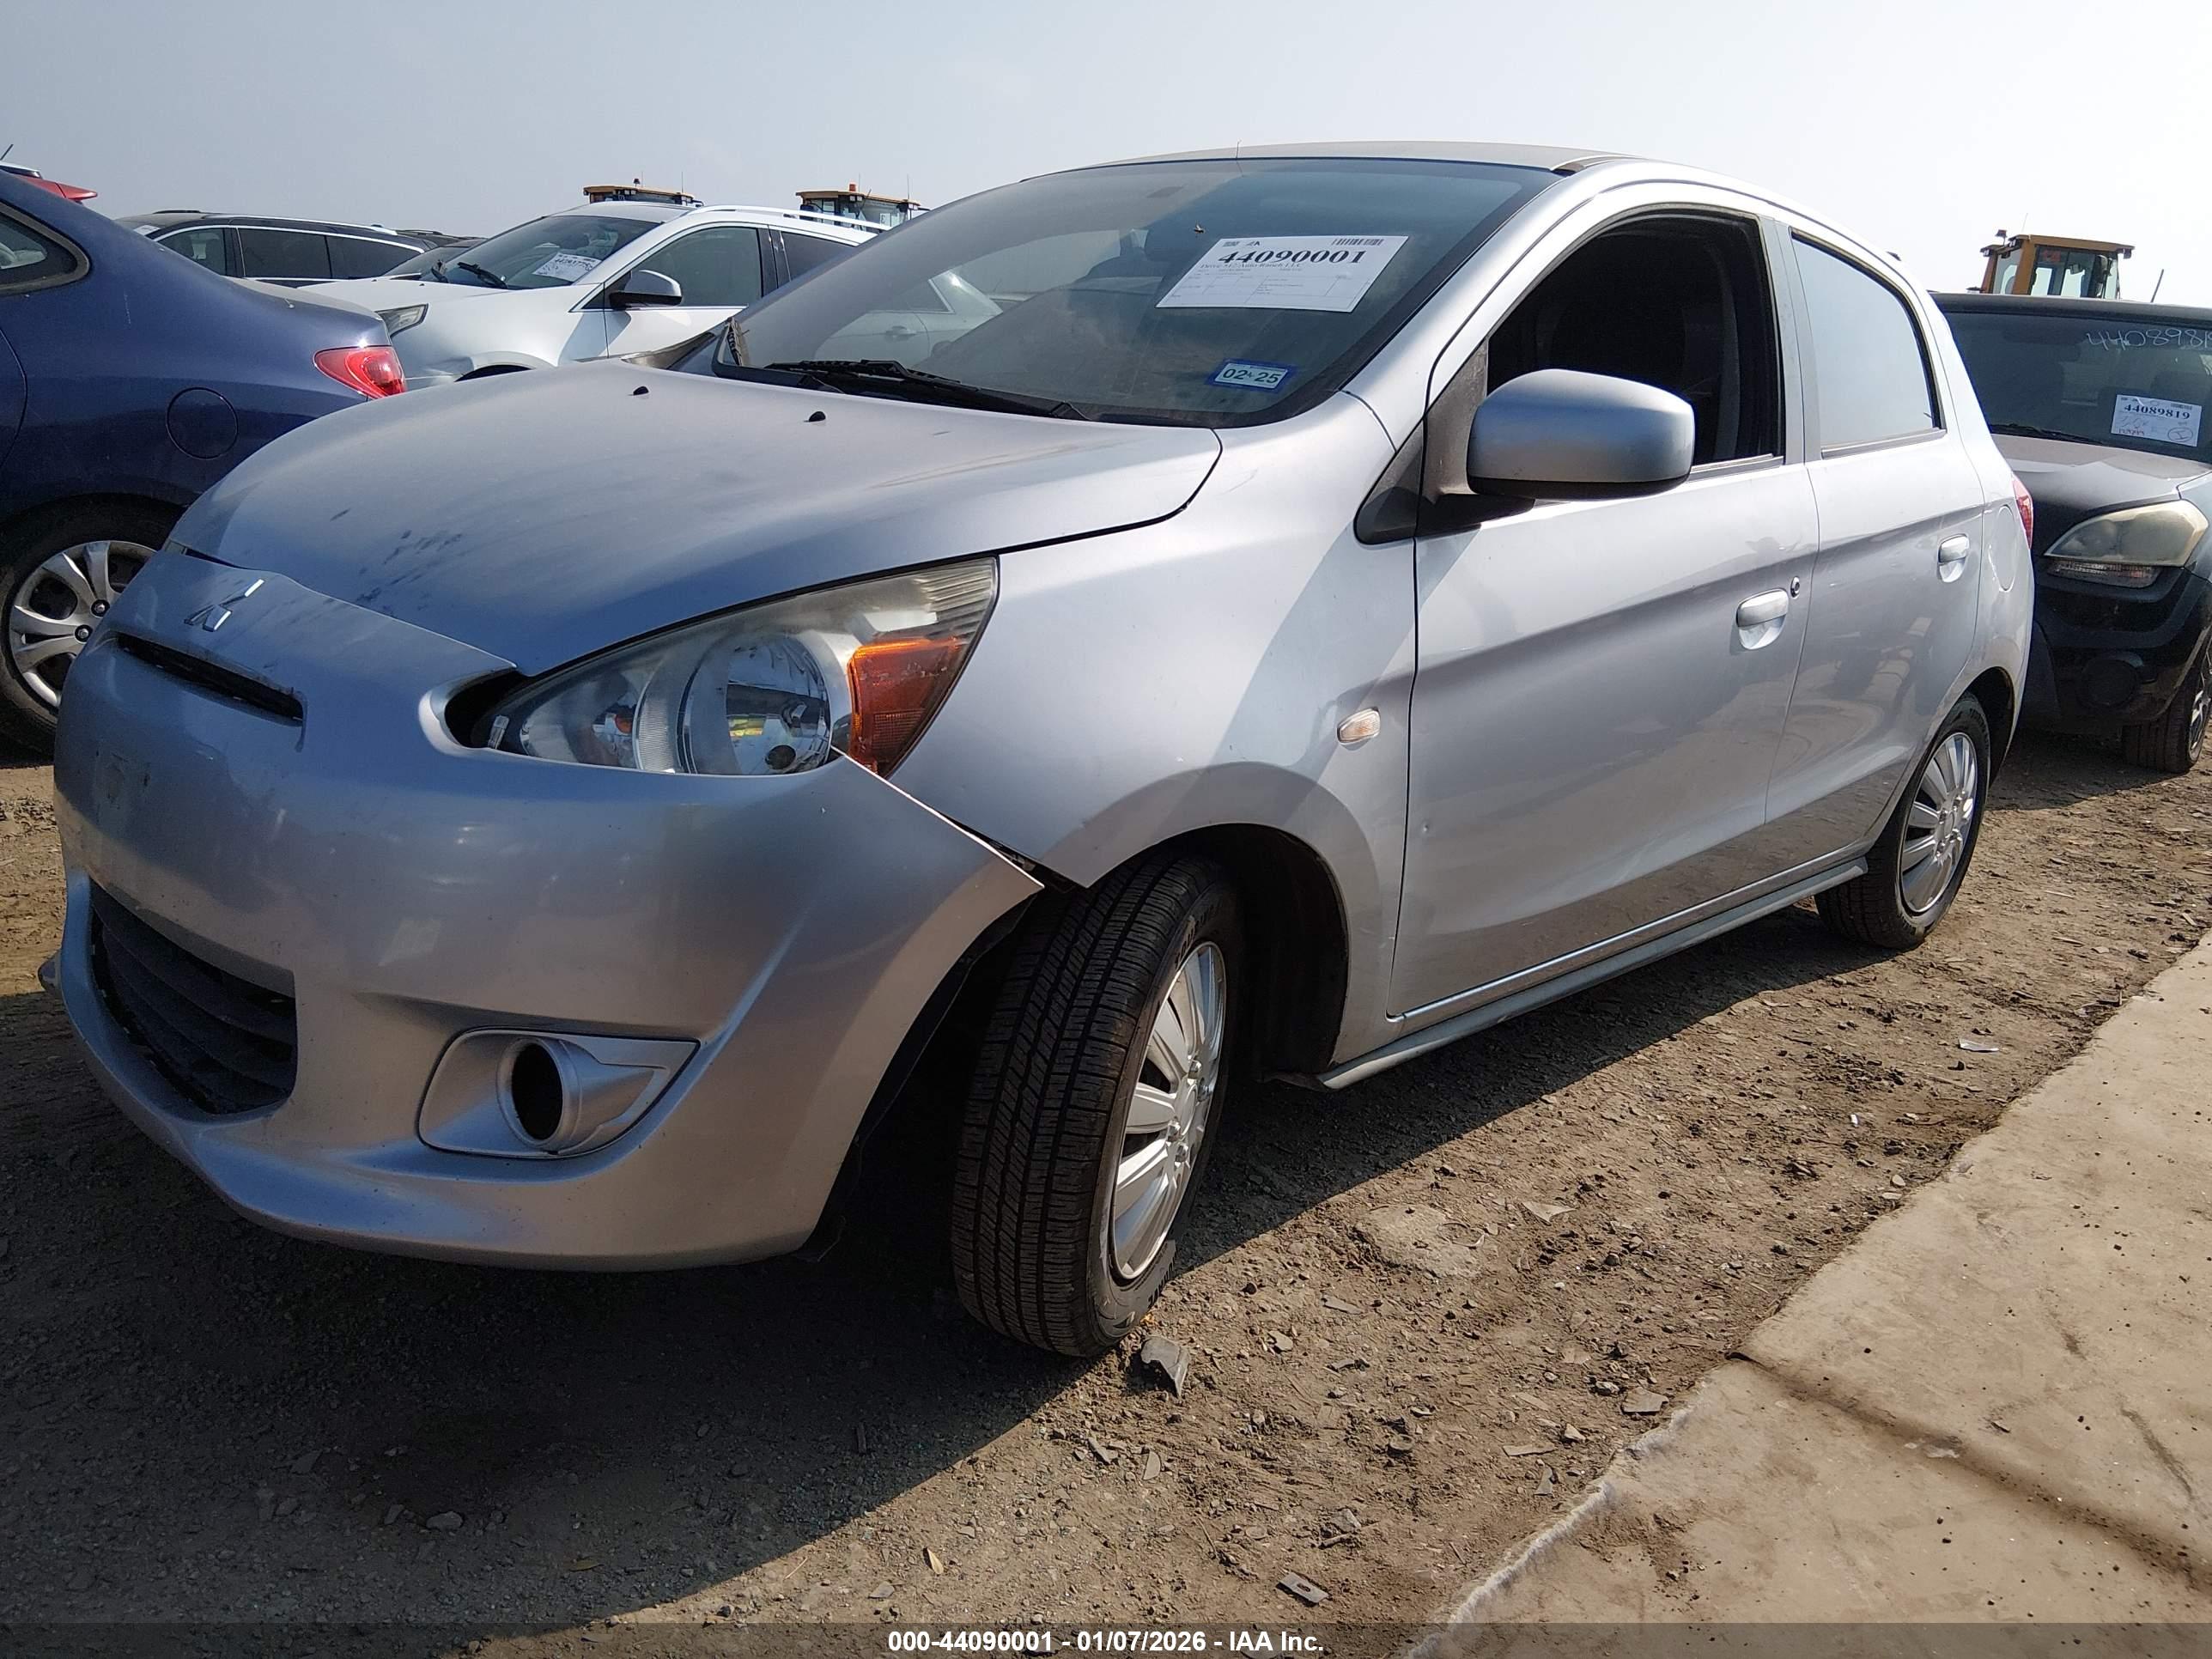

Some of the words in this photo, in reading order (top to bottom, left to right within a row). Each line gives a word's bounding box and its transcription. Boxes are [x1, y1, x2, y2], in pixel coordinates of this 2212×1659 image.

[1218, 250, 1367, 264] 44090001
[1223, 368, 1248, 380] 02
[1254, 372, 1281, 384] 25
[2124, 404, 2191, 420] 44089819
